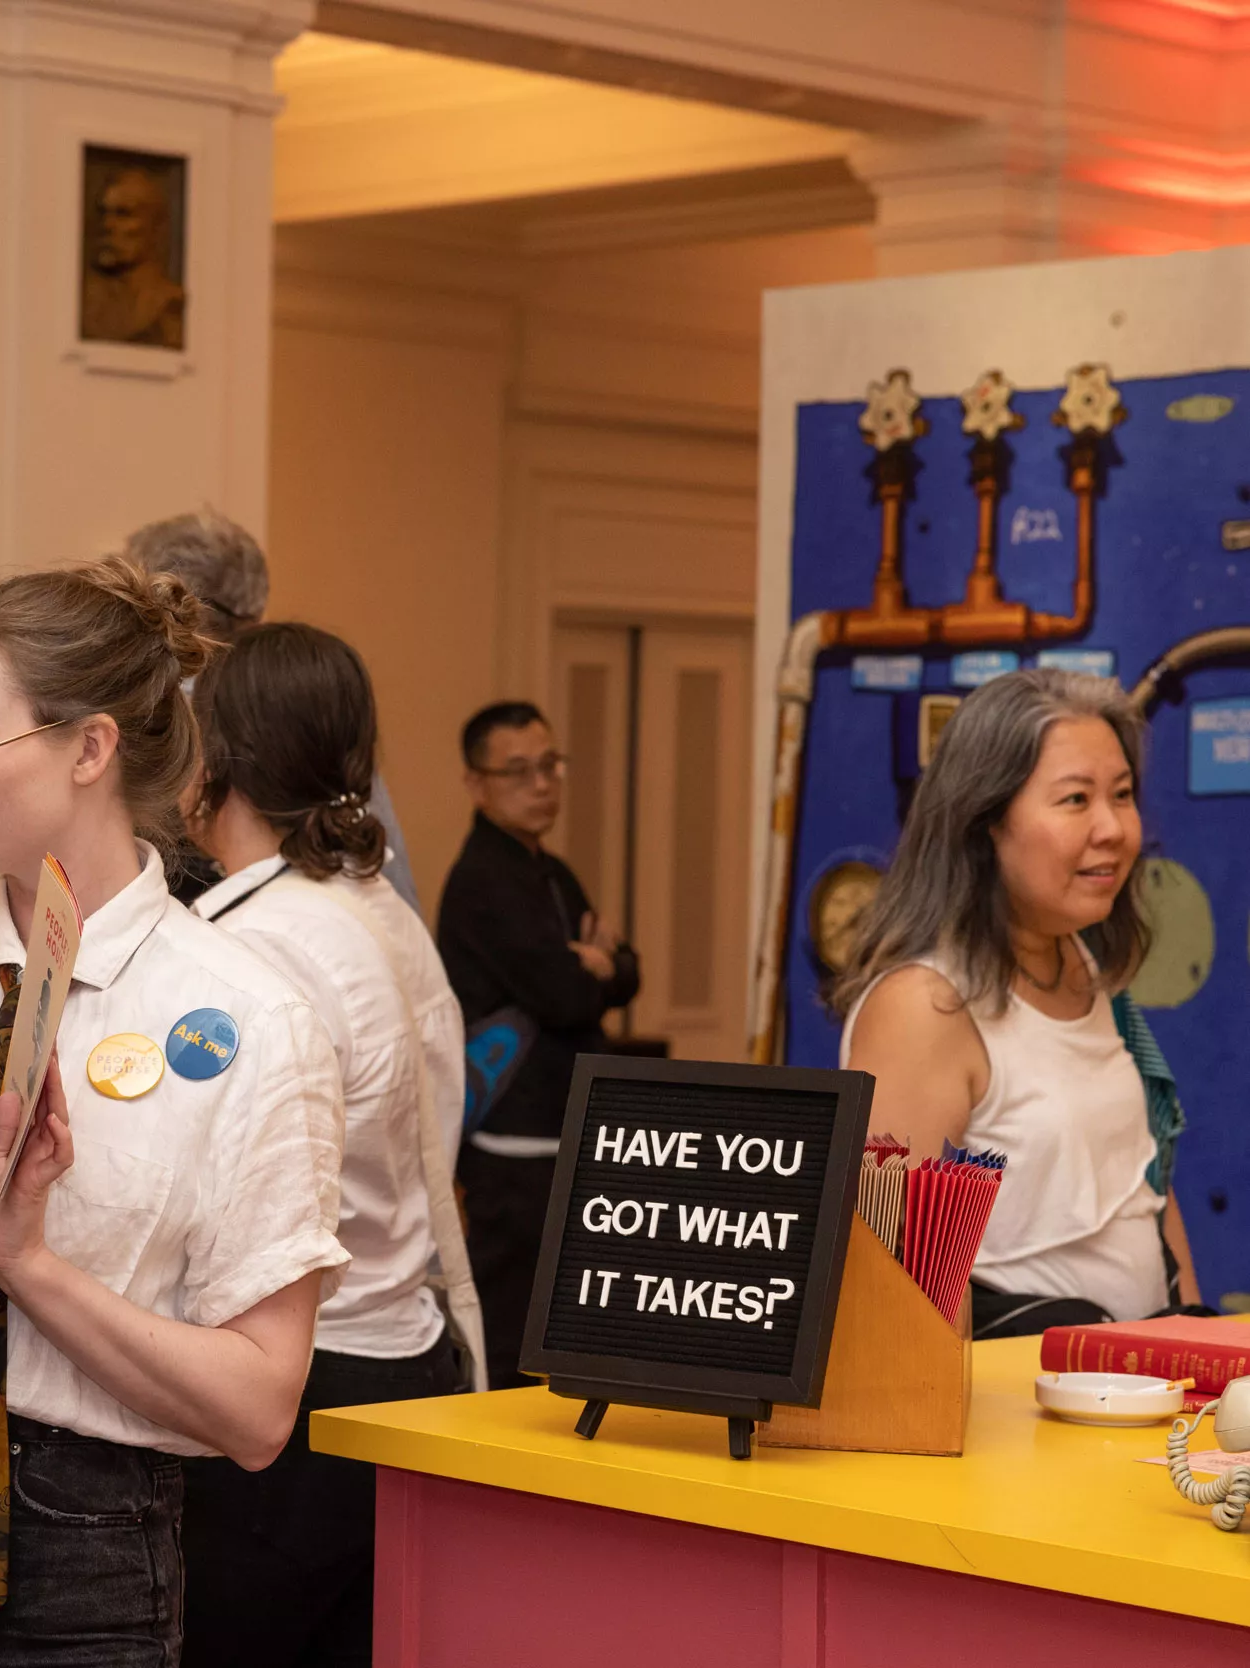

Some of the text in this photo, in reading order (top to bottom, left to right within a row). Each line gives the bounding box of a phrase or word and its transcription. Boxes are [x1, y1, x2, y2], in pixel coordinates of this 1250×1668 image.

[45, 930, 65, 970] HOUS
[96, 1054, 159, 1066] PEOPLE'S
[174, 1023, 228, 1058] Ask me
[103, 1064, 150, 1074] HOUSE
[594, 1125, 804, 1176] HAVE YOU
[582, 1194, 799, 1251] GOT WHAT
[578, 1269, 795, 1330] IT TAKES?
